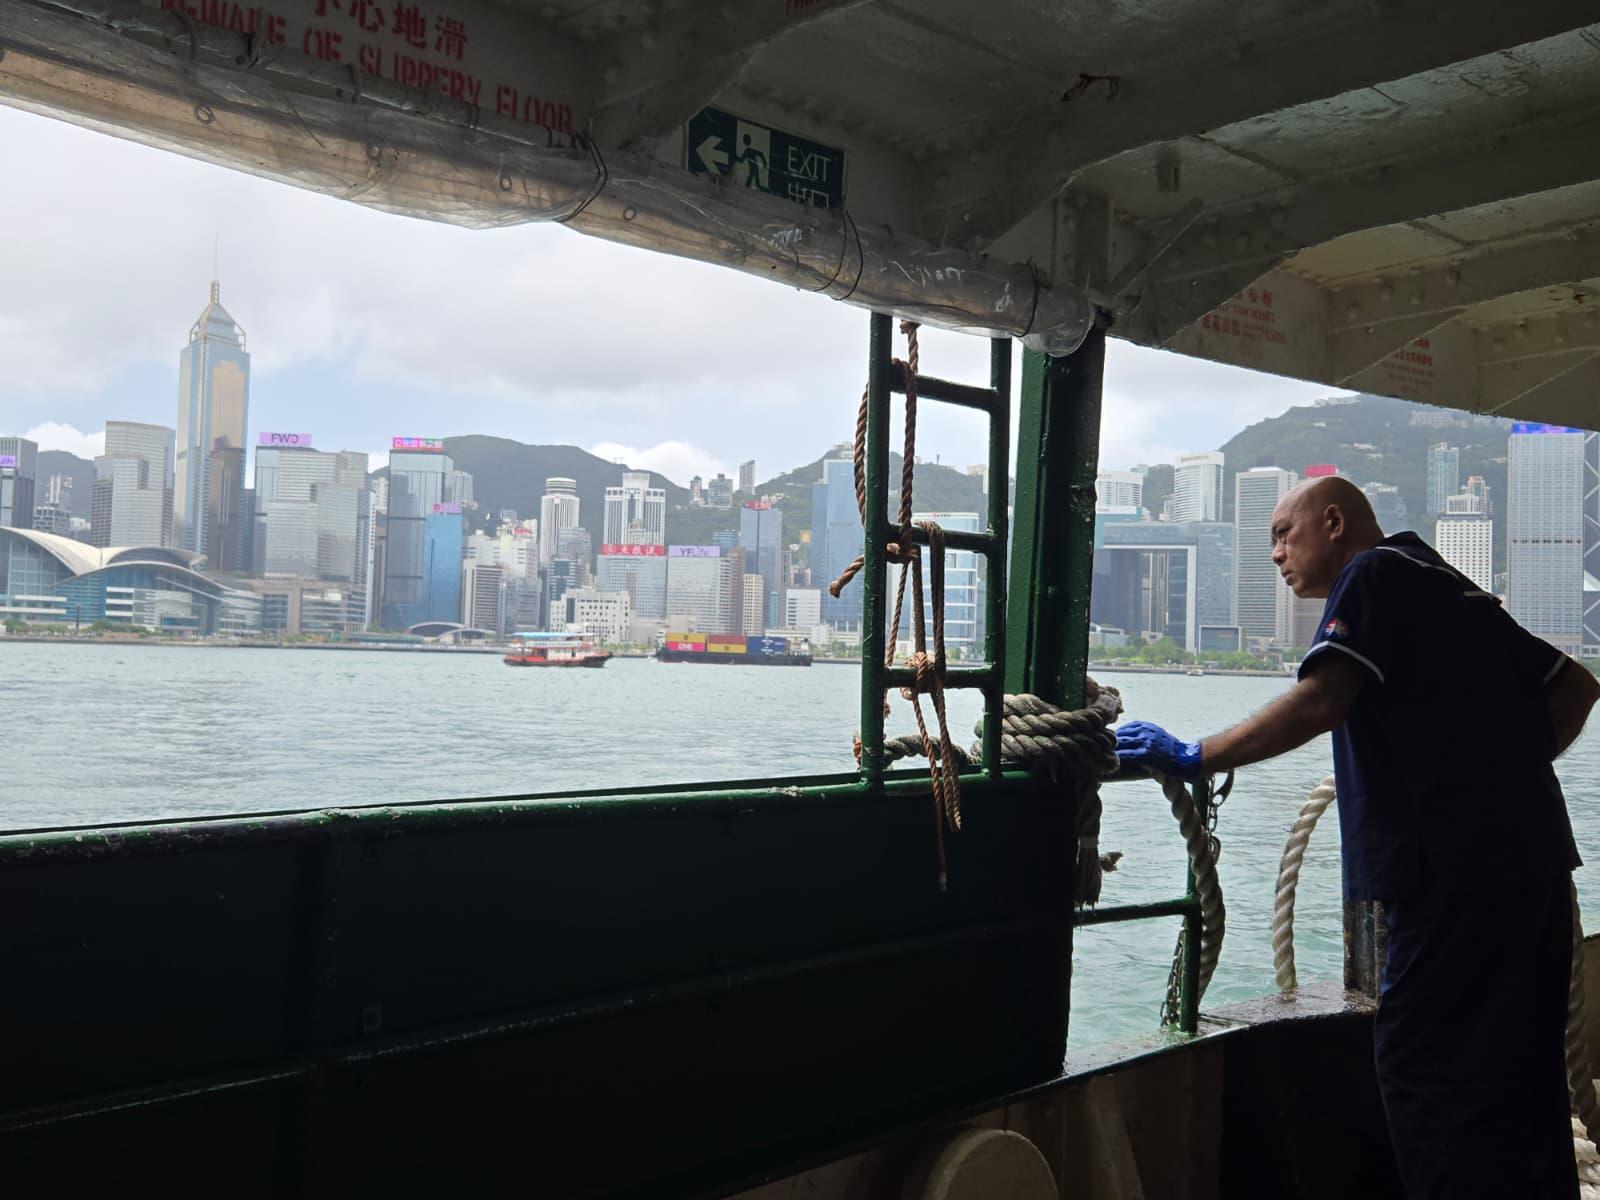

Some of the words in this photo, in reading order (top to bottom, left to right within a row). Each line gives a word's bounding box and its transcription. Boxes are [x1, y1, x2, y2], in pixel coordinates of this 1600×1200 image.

[303, 27, 343, 61] OF
[359, 44, 482, 105] SLIPPERY
[496, 83, 573, 133] FLOOR
[787, 145, 831, 182] EXIT
[271, 433, 298, 444] FWD
